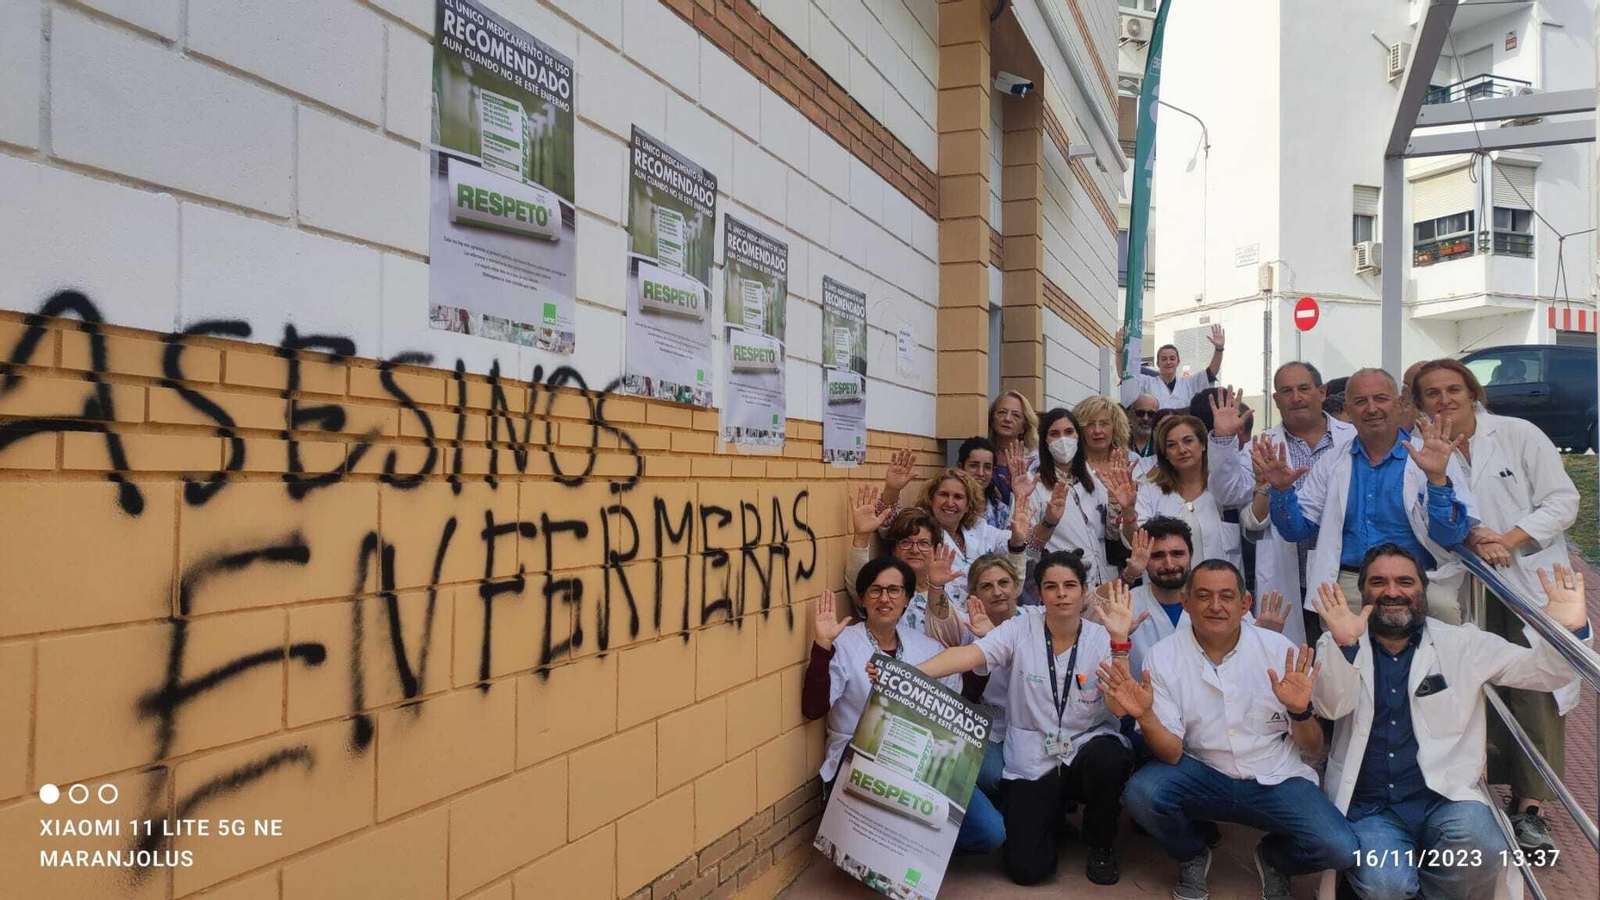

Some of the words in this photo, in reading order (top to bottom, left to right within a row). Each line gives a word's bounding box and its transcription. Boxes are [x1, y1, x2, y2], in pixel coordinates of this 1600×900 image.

[442, 36, 463, 54] AUN
[464, 48, 499, 73] CUANDO
[500, 68, 513, 81] NO
[514, 75, 524, 87] SE
[540, 91, 570, 112] ENFERMO
[443, 9, 570, 99] RECOMENDADO
[486, 21, 543, 60] MEDICAMENTO
[544, 55, 554, 68] DE
[554, 61, 570, 77] USO
[634, 148, 714, 207] RECOMENDADO
[647, 175, 669, 193] CUANDO
[669, 187, 678, 198] NO
[457, 183, 548, 227] RESPETO
[727, 232, 786, 272] RECOMENDADO
[643, 279, 698, 309] RESPETO
[824, 290, 865, 318] RECOMENDADO
[733, 344, 776, 364] RESPETO
[0, 288, 643, 516] ASESINOS
[829, 381, 858, 395] RESPETO
[134, 488, 818, 880] ENFERMERAS
[875, 659, 884, 667] EL
[885, 661, 912, 680] ÚNICO
[912, 676, 964, 710] MEDICAMENTO
[964, 707, 974, 716] DE
[974, 713, 989, 727] USO
[884, 688, 915, 709] CUANDO
[916, 706, 928, 716] NO
[928, 713, 937, 722] SE
[952, 728, 983, 749] ENFERMO
[850, 767, 934, 816] RESPETO
